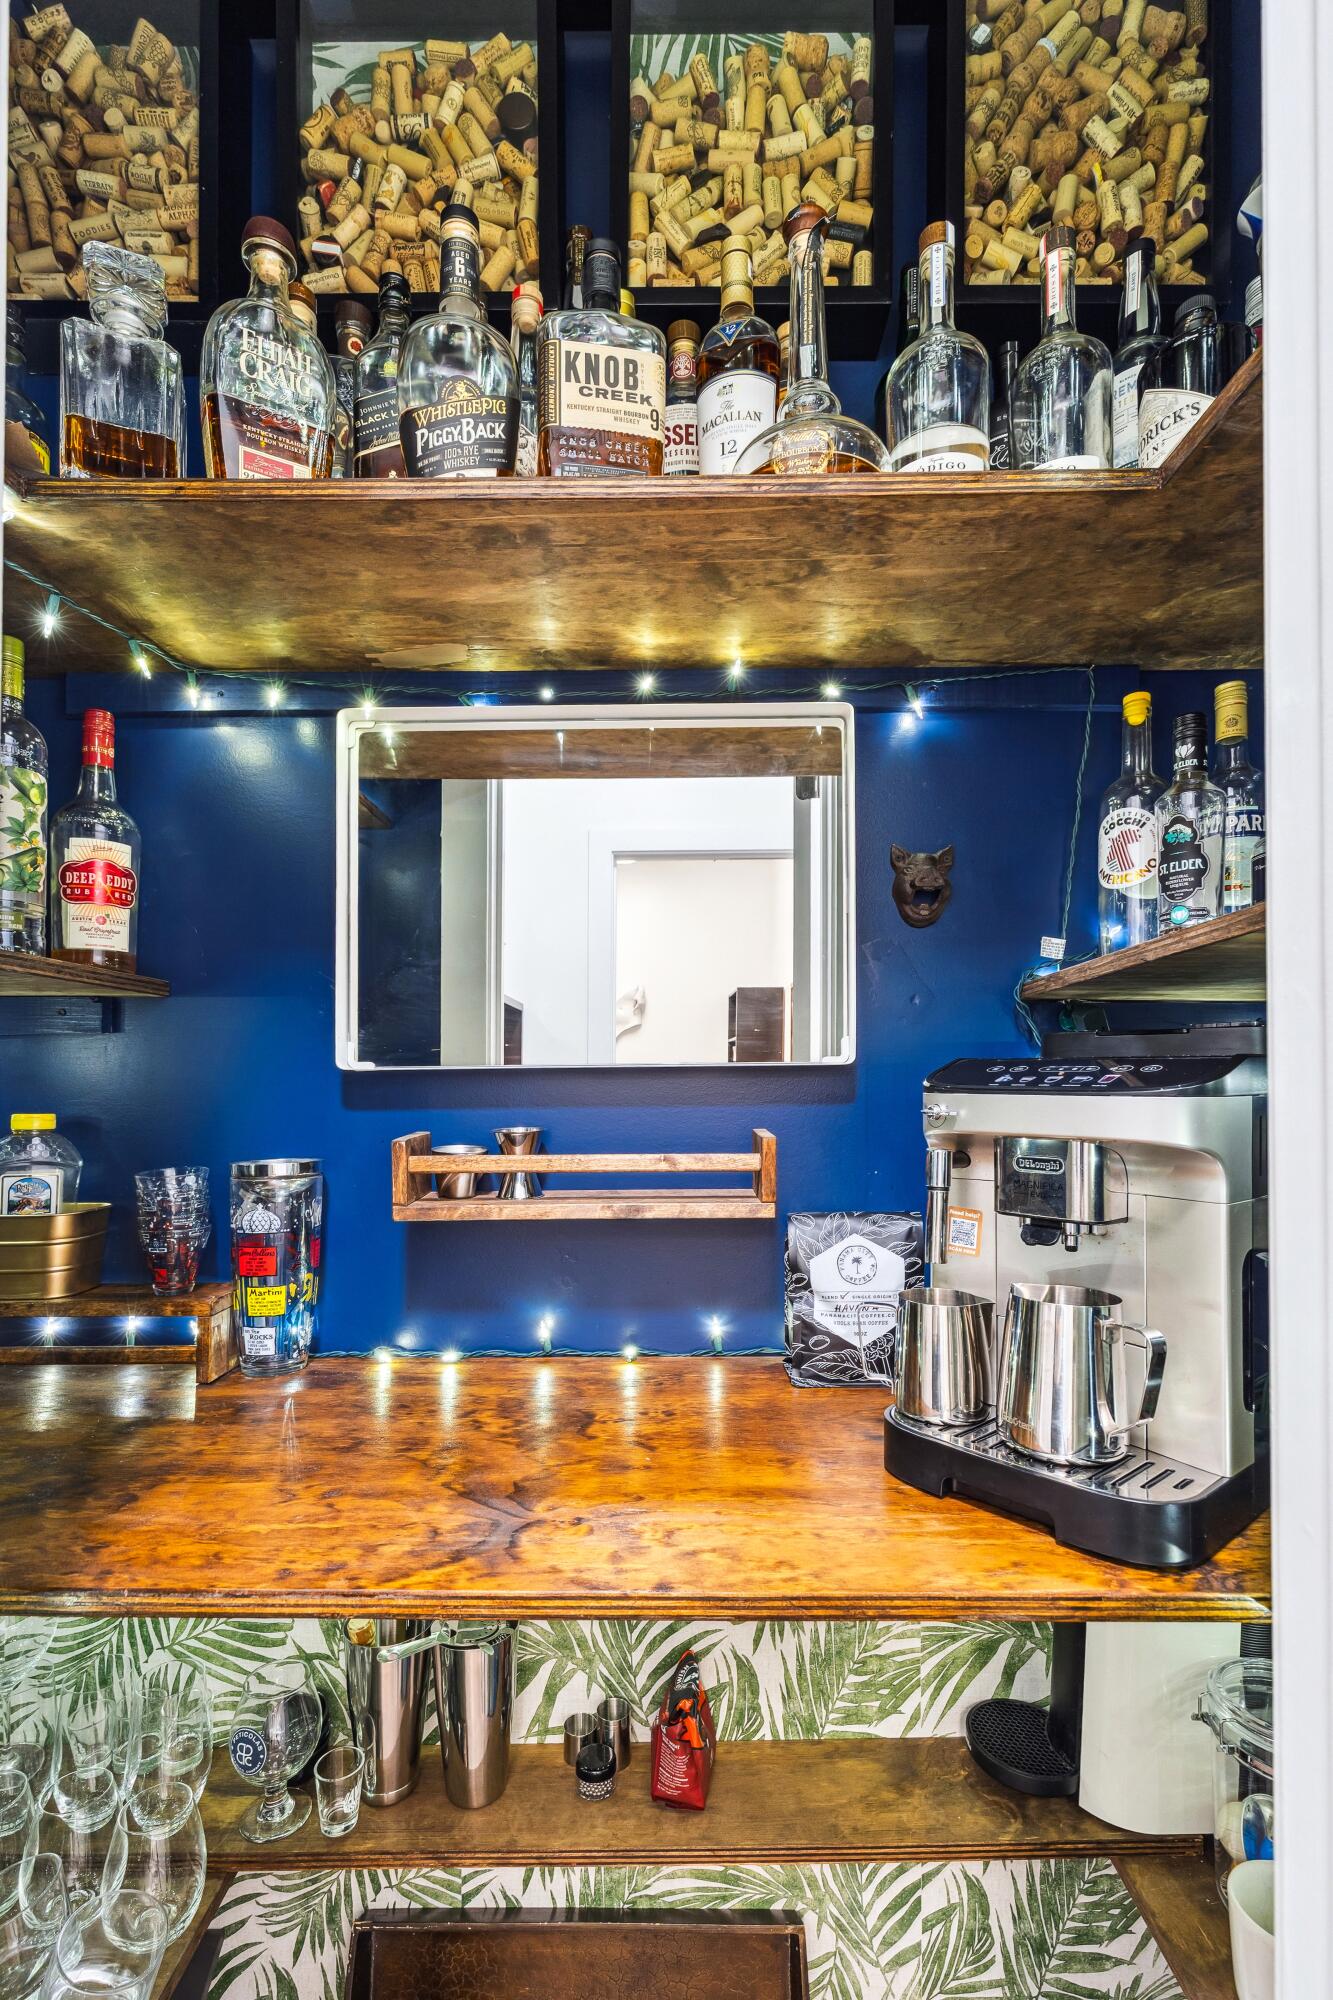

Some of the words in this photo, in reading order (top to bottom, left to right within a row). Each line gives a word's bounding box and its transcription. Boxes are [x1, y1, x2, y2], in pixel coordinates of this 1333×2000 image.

[83, 179, 114, 191] TERRAIN
[73, 223, 111, 239] FOODIES
[450, 250, 470, 259] AGED
[454, 256, 465, 277] 6
[449, 277, 472, 287] YEARS
[724, 324, 737, 334] 12
[240, 327, 313, 375] ELIJAH
[548, 344, 556, 380] KENTUCKY
[564, 350, 639, 392] KNOB
[239, 351, 313, 397] CRAIG
[548, 383, 556, 421] CLERMONT,
[578, 385, 654, 408] CREEK
[360, 401, 389, 416] JOHNNIE
[412, 397, 507, 428] WHISTLEPIG
[566, 403, 595, 413] KENTUCKY
[596, 406, 622, 415] STRAIGHT
[623, 409, 649, 420] BOURBON
[355, 411, 390, 428] BLACK
[613, 415, 640, 425] WHISKEY
[650, 408, 660, 431] 9
[702, 411, 762, 435] MACALLAN
[242, 424, 278, 440] KENTUCKY
[414, 417, 506, 457] PIGGYBACK
[246, 432, 277, 446] BOURBON
[278, 441, 306, 456] WHISKEY
[463, 444, 479, 457] RYE
[605, 440, 649, 455] CREEK
[719, 439, 738, 457] 12
[443, 456, 480, 470] WHISKEY
[558, 447, 602, 460] SMALL
[608, 452, 649, 467] BATCH
[1104, 816, 1147, 836] COCCHI
[1169, 858, 1204, 873] ELDER
[65, 871, 96, 885] DEEP
[106, 874, 134, 891] EDDY
[66, 888, 100, 896] RUBY
[114, 892, 132, 901] RED
[249, 1289, 282, 1297] Martini
[232, 1731, 264, 1751] PETICOLAS
